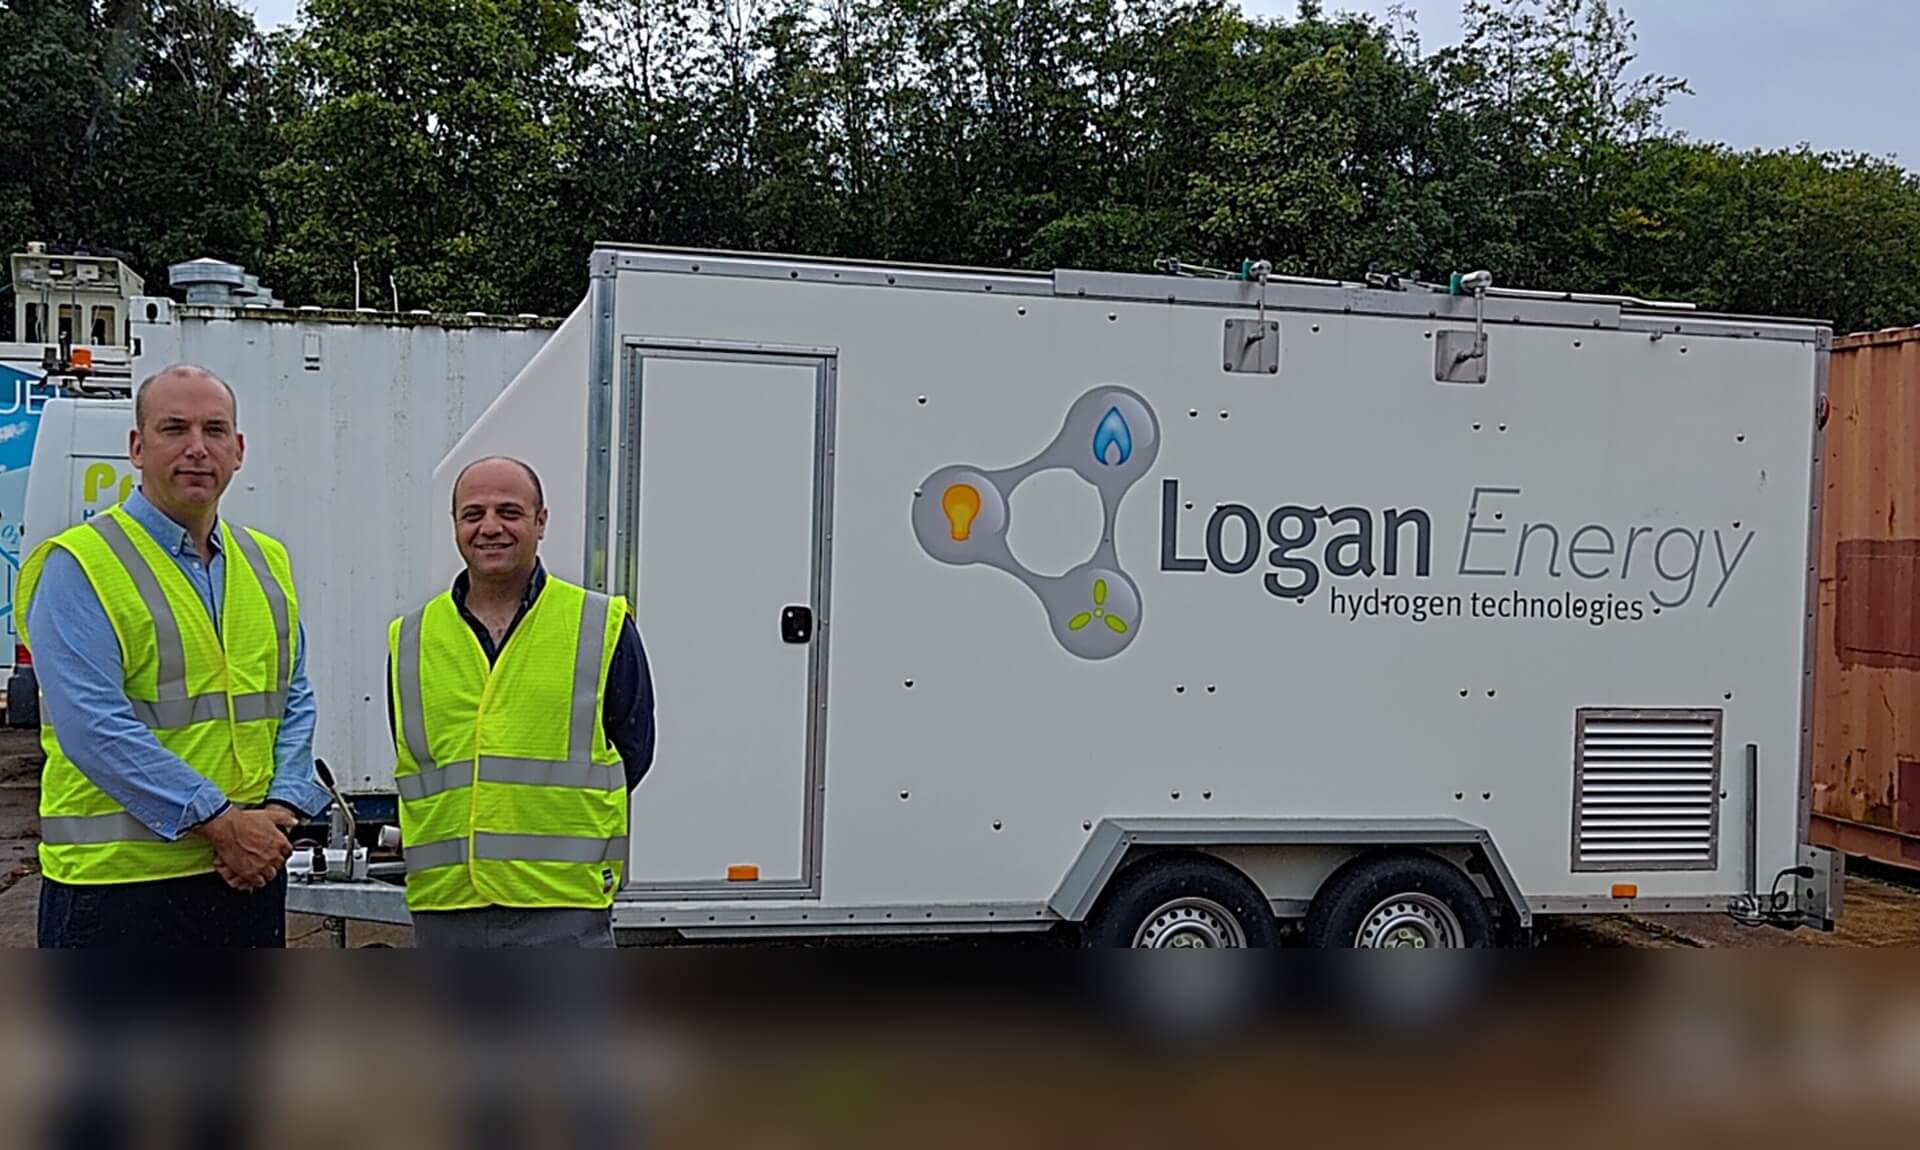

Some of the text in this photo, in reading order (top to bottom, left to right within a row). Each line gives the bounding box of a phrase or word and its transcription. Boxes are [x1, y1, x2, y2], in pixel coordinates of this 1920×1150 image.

[1161, 479, 1755, 608] Logan Energy
[1331, 587, 1644, 625] hydrogen technologies
